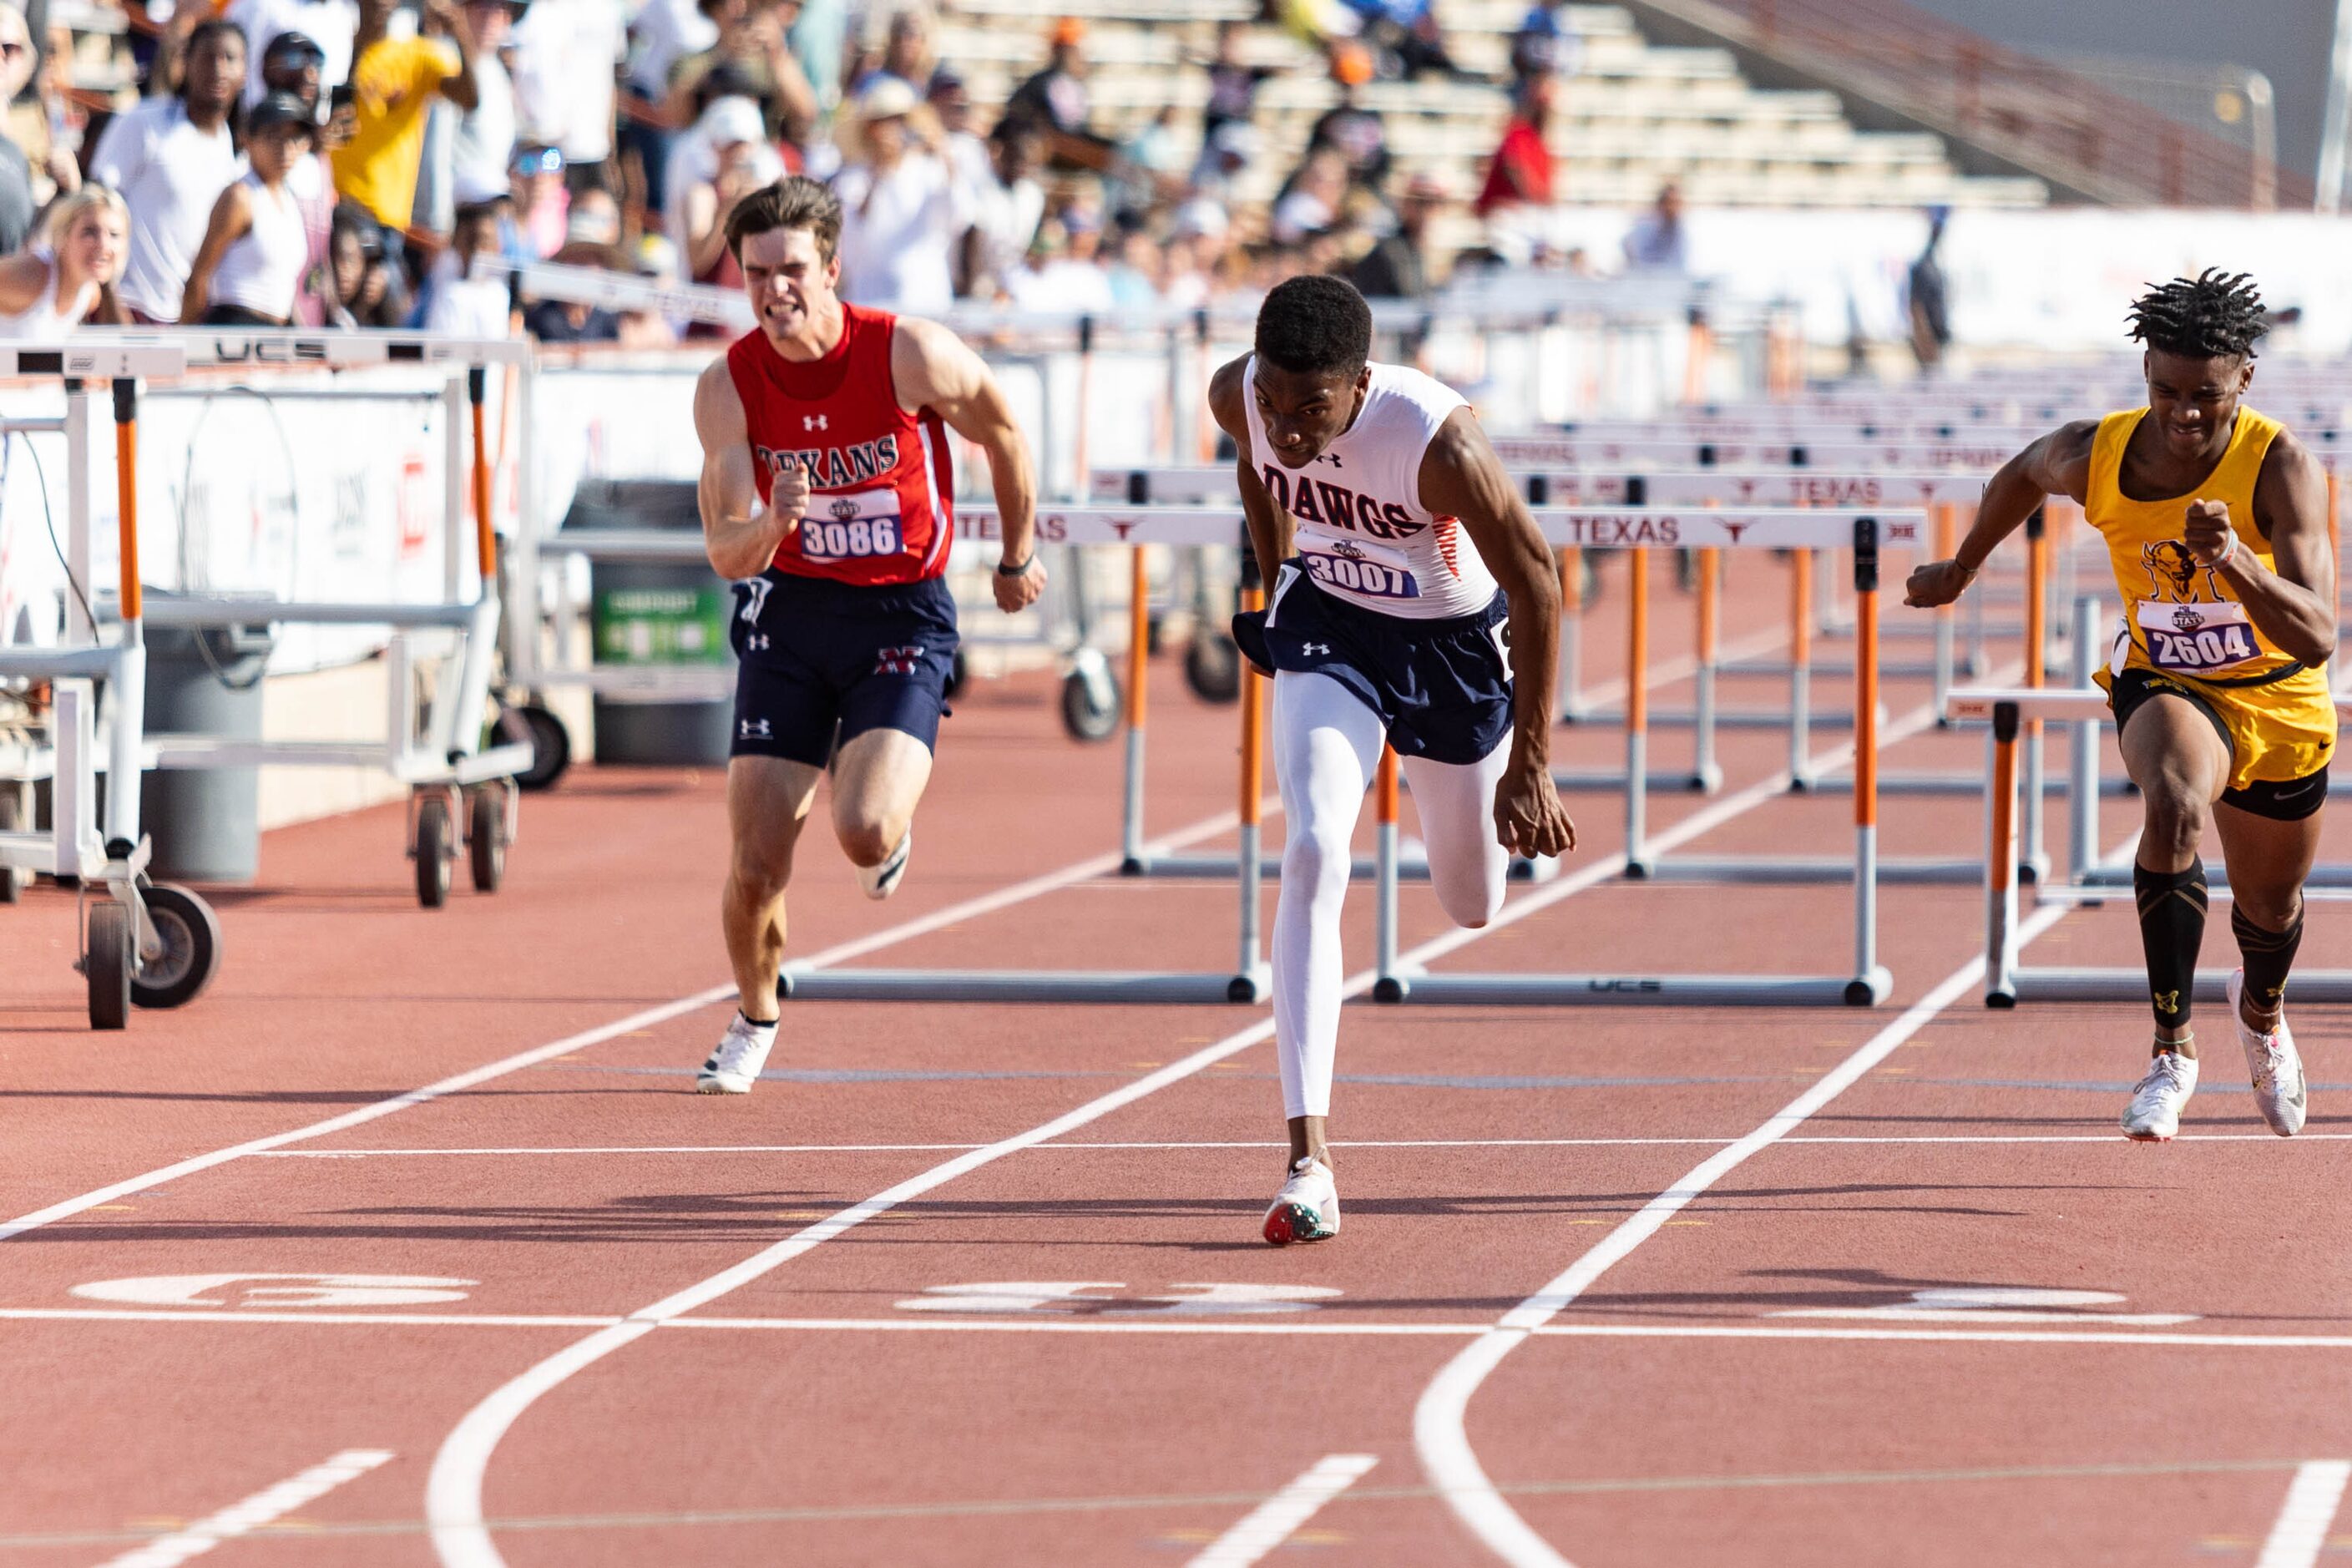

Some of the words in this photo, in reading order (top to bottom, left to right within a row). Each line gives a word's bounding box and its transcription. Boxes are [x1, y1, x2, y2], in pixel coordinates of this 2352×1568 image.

[215, 339, 326, 362] UCS
[1263, 463, 1428, 539] DAWGS
[1790, 481, 1881, 500] TEXAS
[803, 518, 896, 556] 3086
[958, 514, 1067, 541] TES
[1570, 516, 1680, 543] TEXAS
[1307, 554, 1404, 594] 3007
[2172, 615, 2205, 626] STATE
[2152, 625, 2251, 665] 2604
[1589, 979, 1661, 992] UCS
